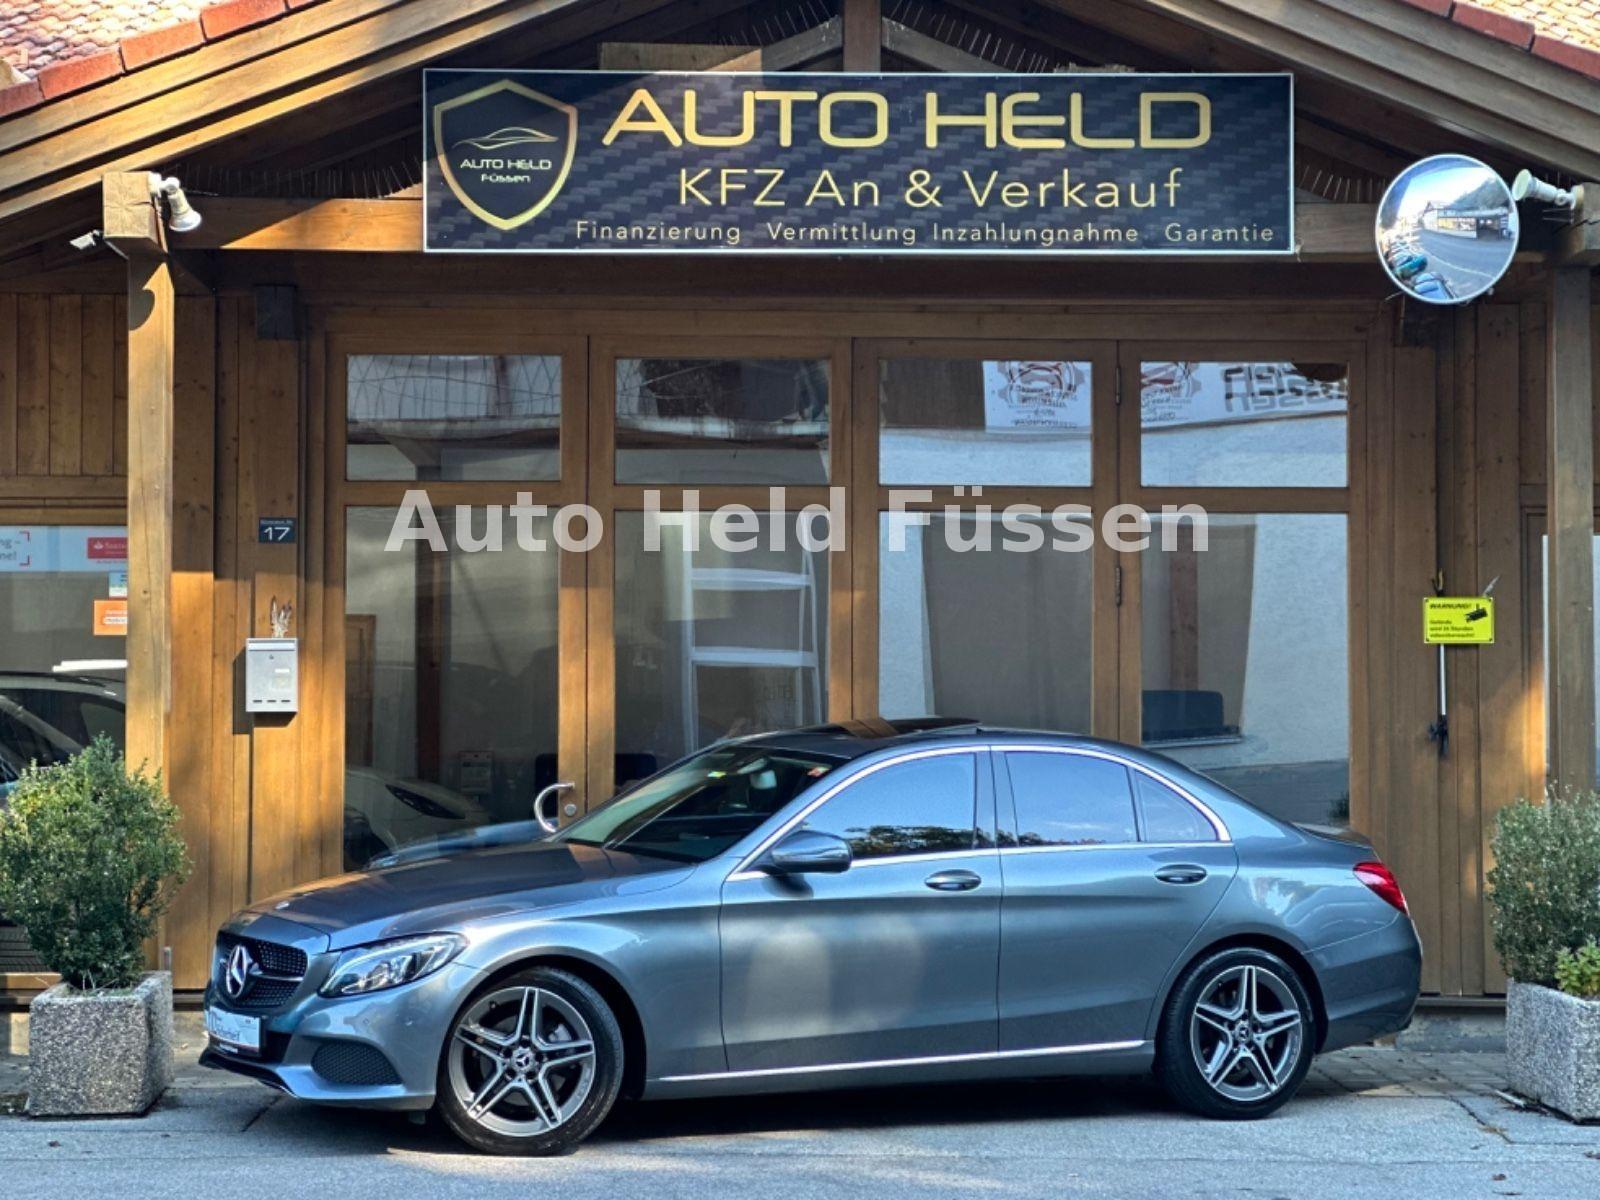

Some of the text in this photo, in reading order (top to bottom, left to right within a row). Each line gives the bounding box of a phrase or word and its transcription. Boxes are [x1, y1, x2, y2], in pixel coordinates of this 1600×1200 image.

[601, 88, 1212, 150] AUTO HELD
[460, 159, 553, 170] AUTO HELD
[680, 167, 1184, 208] KFZ An & Verkauf
[576, 220, 1274, 246] Finanzierung Vermittlung Inzahlungnahme Garantie
[264, 526, 290, 541] 17
